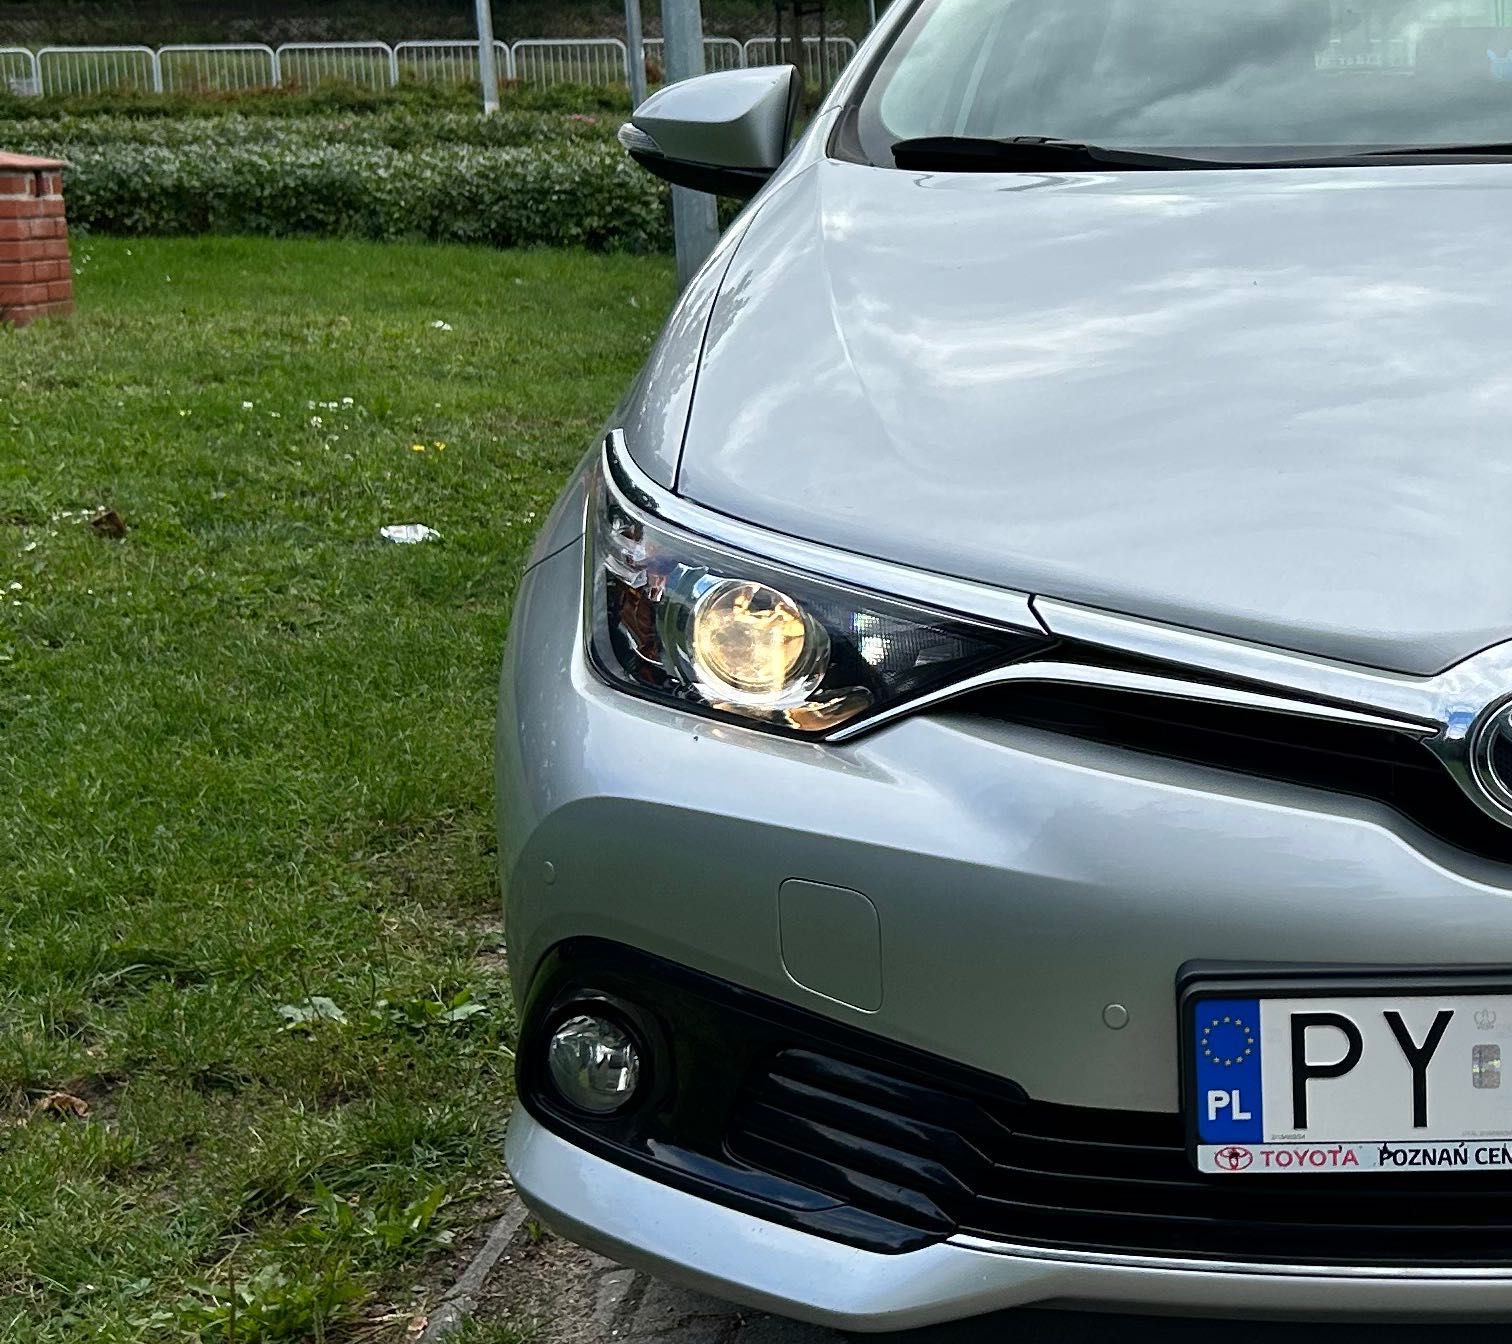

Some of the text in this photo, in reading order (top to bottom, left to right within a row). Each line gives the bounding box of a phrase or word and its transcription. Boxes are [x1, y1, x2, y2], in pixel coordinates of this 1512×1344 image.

[1290, 1010, 1455, 1130] PY
[1207, 1089, 1252, 1121] PL
[1260, 1149, 1360, 1168] TOYOTA
[1378, 1143, 1469, 1167] POZNAŃ
